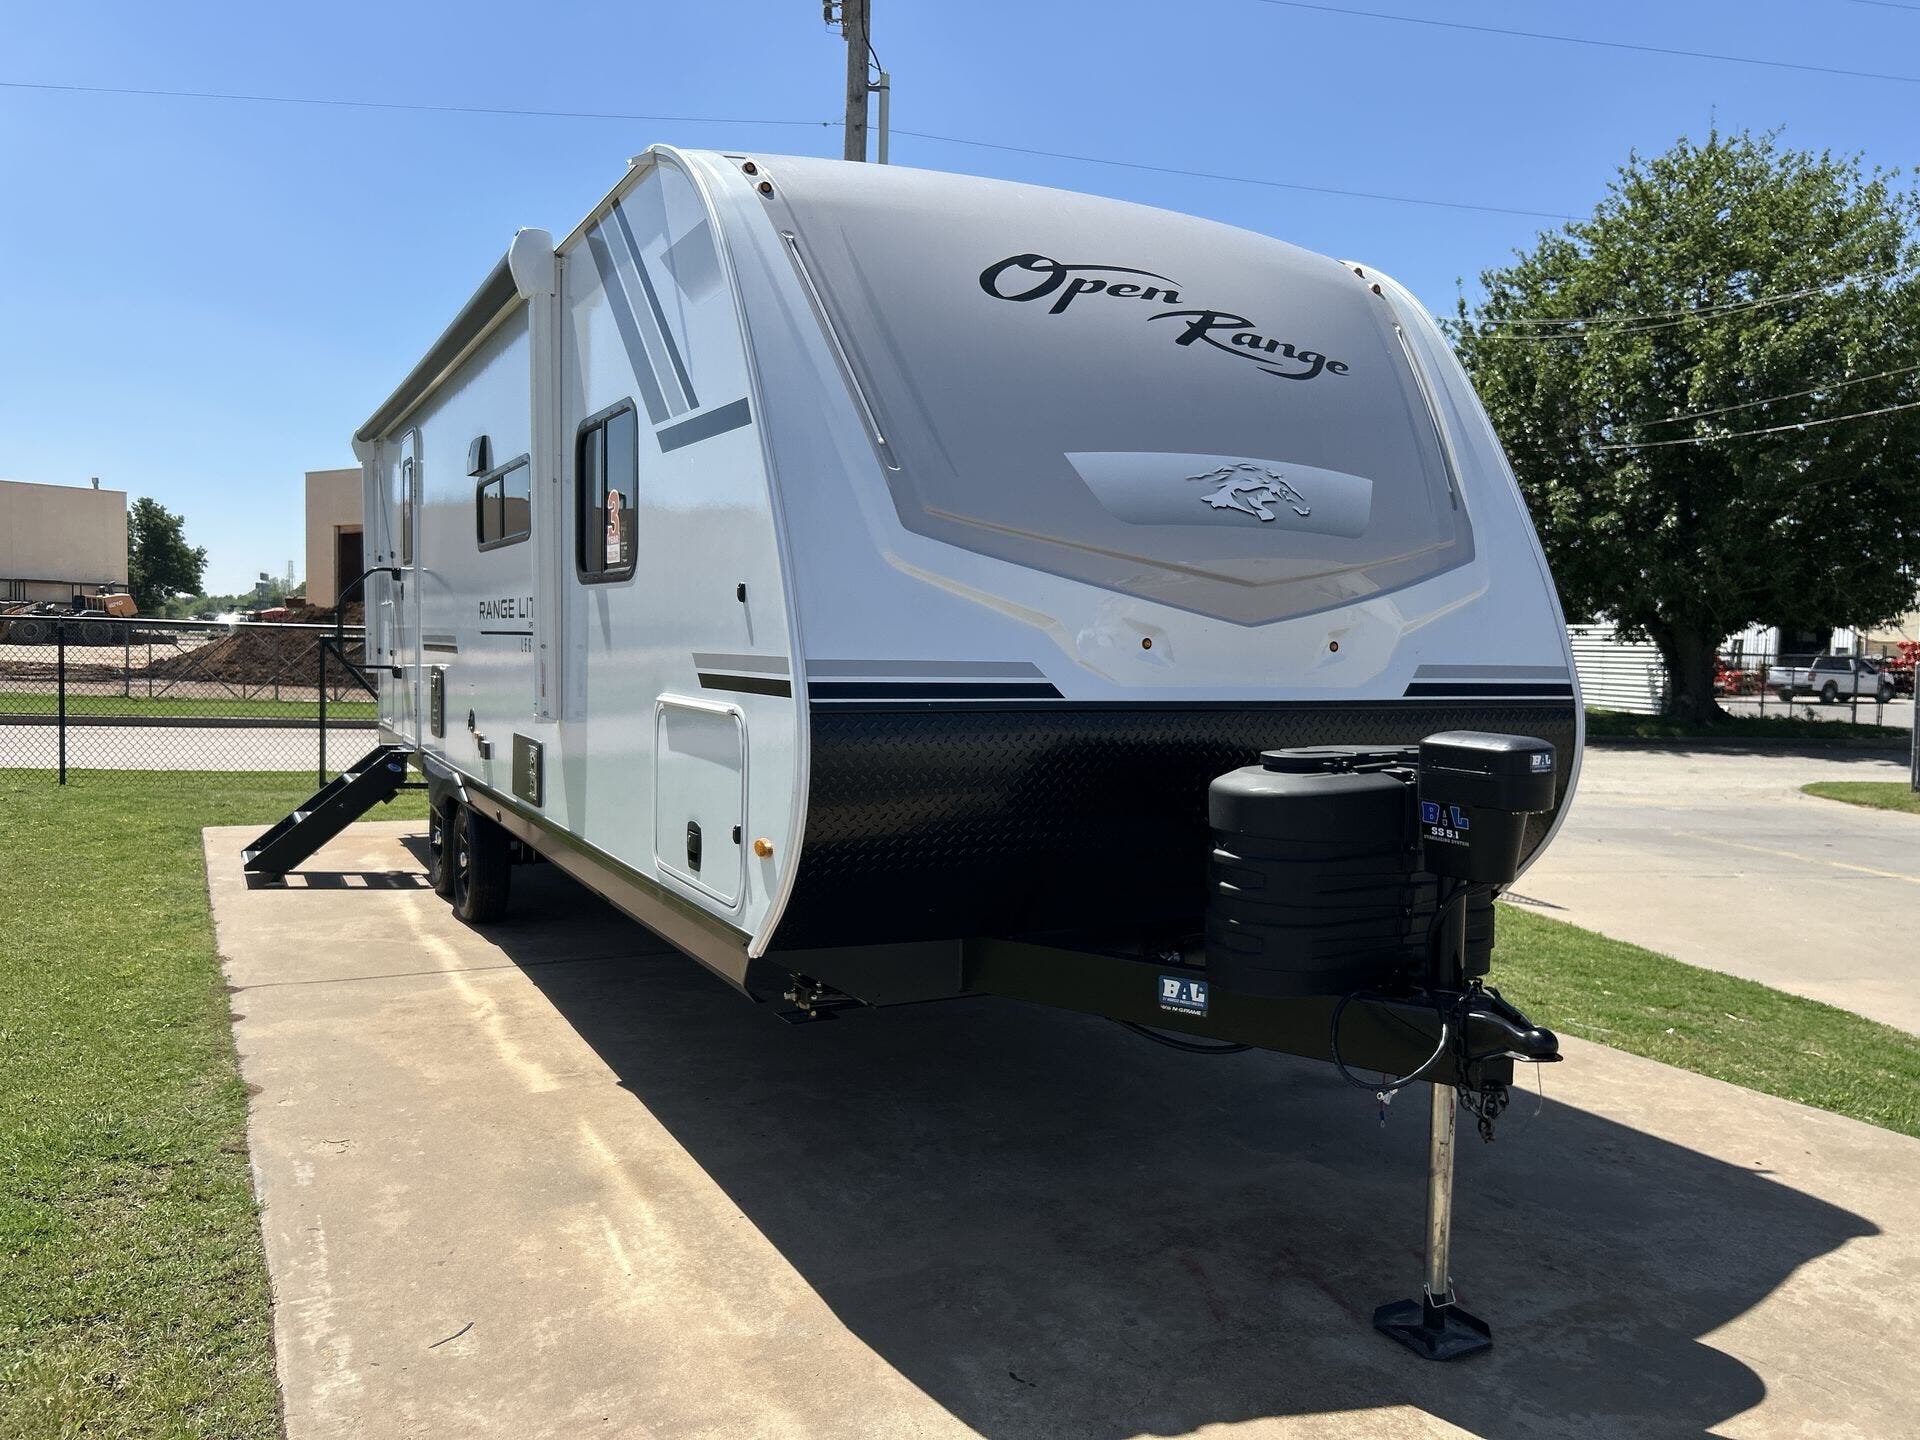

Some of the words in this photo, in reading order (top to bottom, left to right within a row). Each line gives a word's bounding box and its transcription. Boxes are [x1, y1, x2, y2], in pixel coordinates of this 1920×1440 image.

[979, 253, 1184, 315] Open
[1146, 309, 1350, 381] Range
[607, 489, 620, 536] 3
[479, 598, 515, 620] RANGE
[1422, 801, 1469, 830] BAL
[1163, 979, 1205, 1002] BAL
